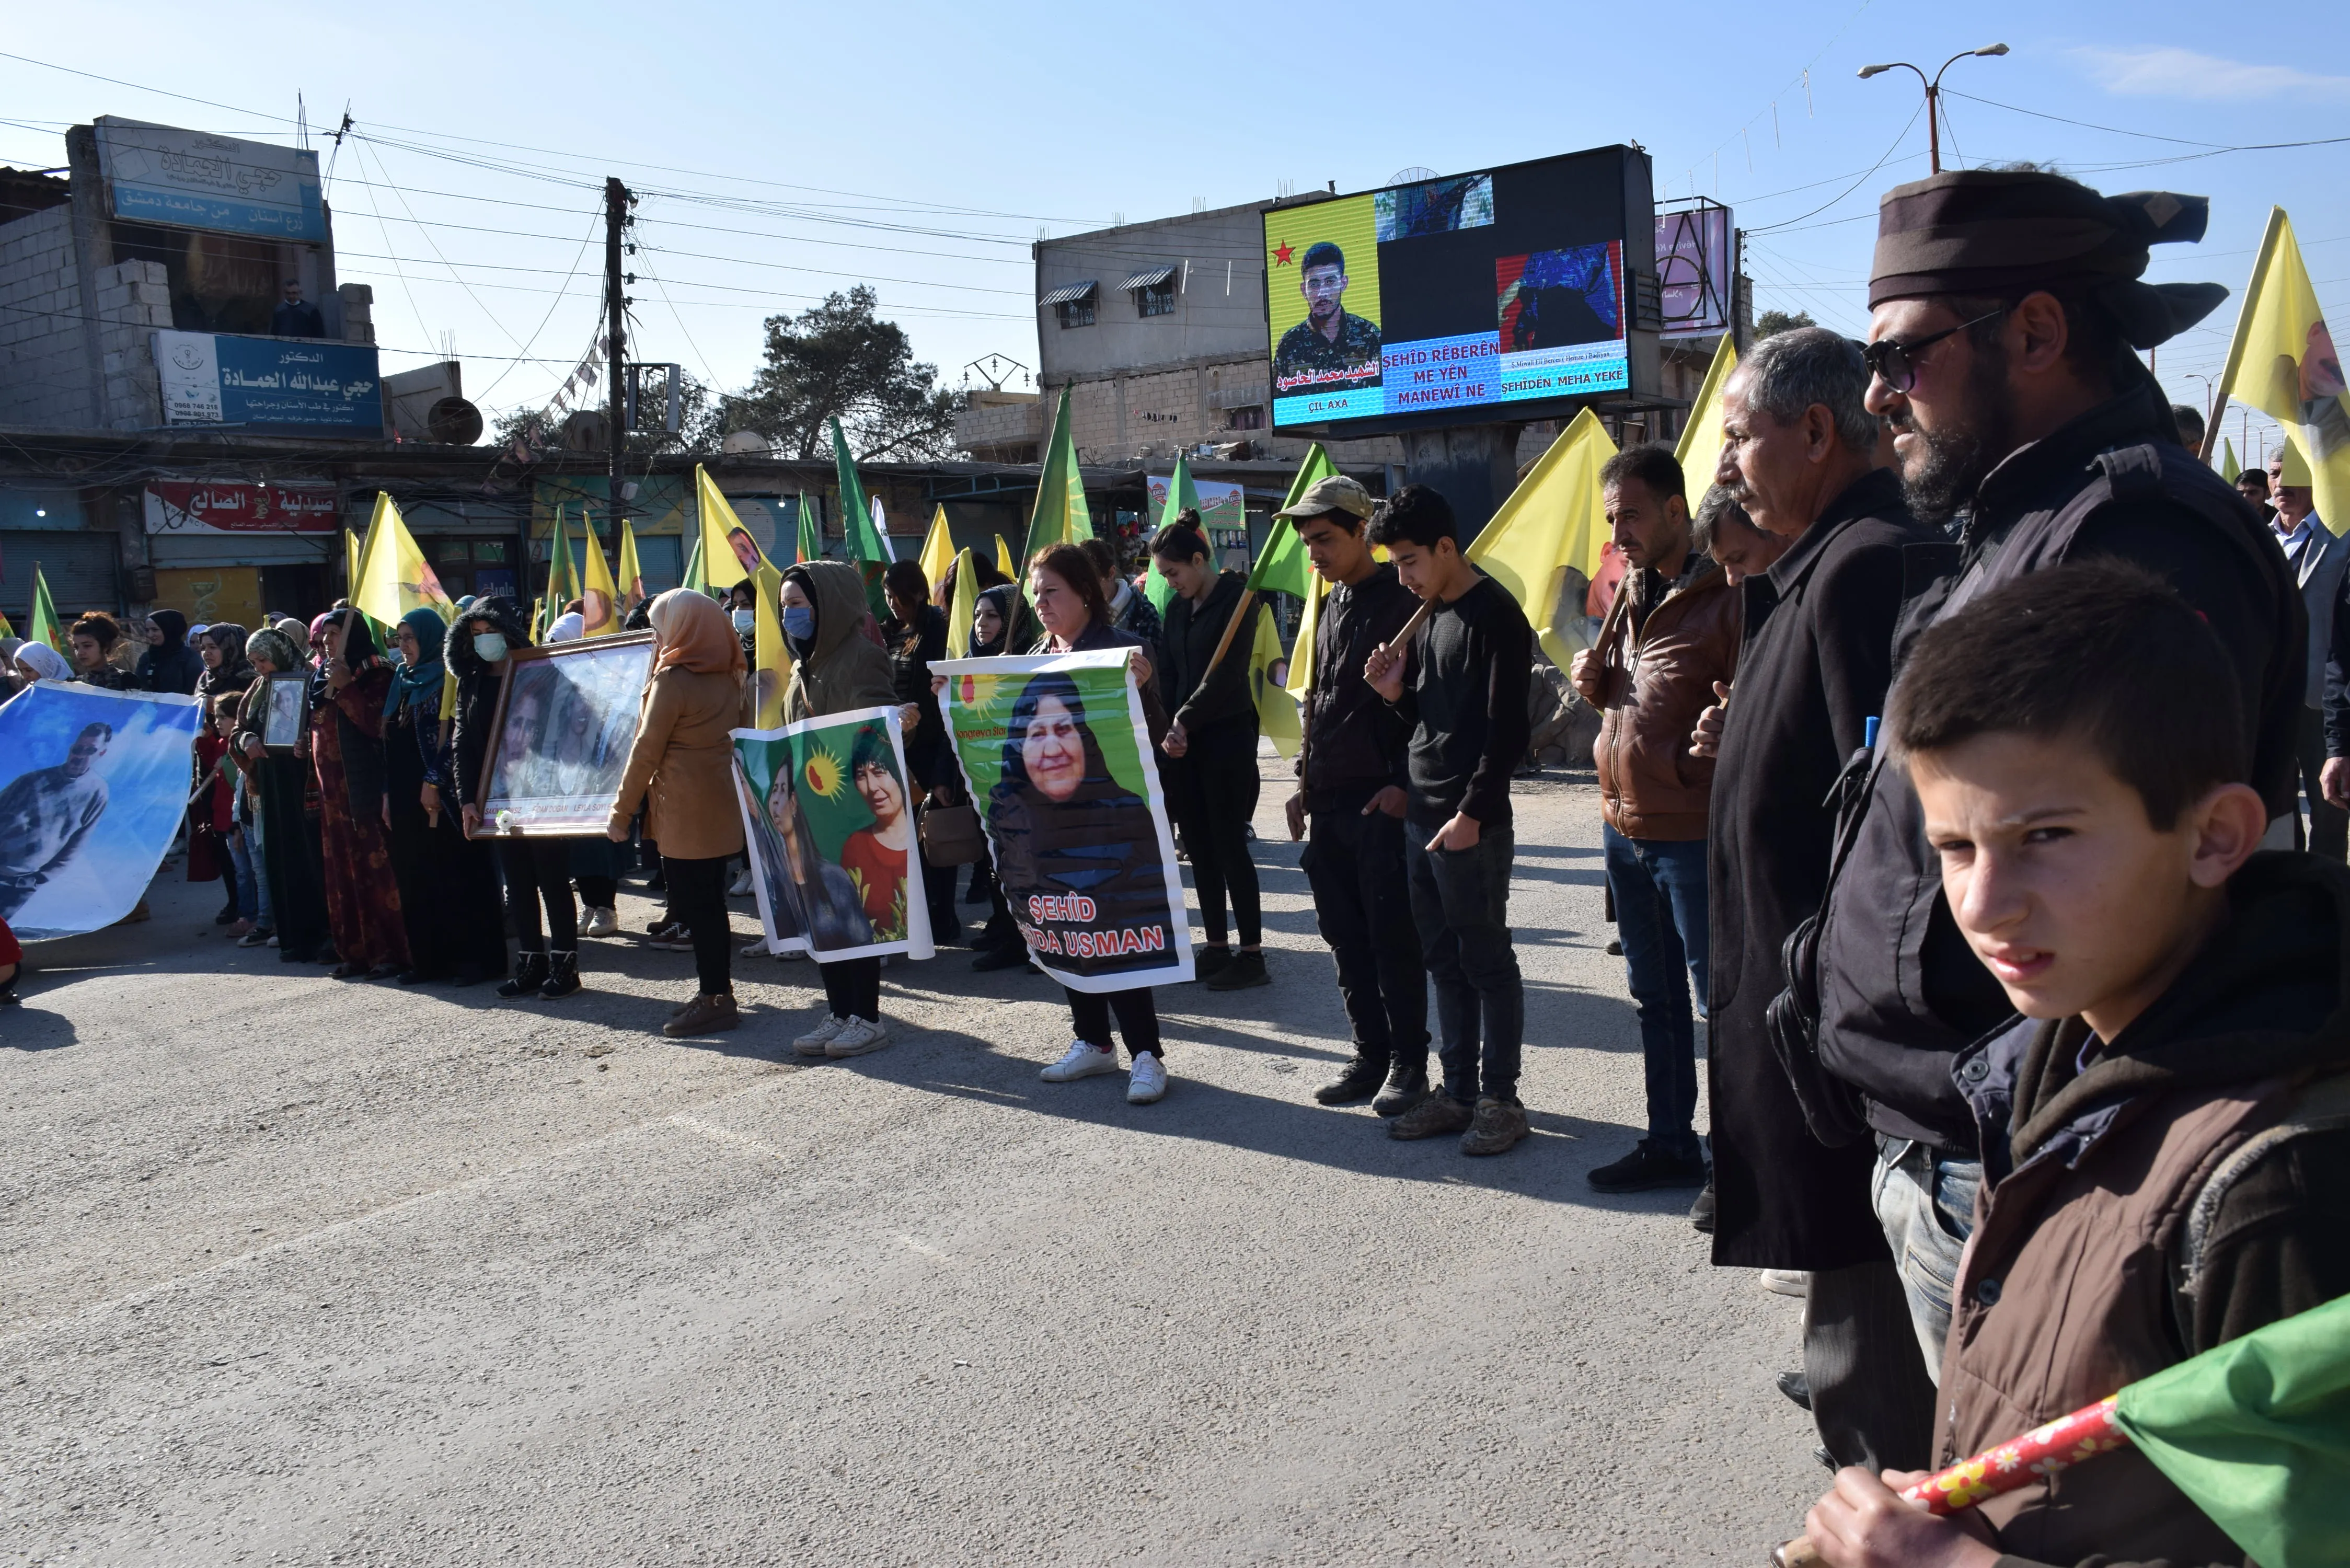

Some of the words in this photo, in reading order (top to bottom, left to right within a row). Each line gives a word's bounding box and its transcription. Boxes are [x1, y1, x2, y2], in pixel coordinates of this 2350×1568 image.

[192, 138, 240, 153] الدكتور
[235, 168, 282, 195] حجي
[121, 191, 162, 207] دمشق
[166, 195, 206, 213] جامعة
[211, 206, 230, 219] من
[279, 351, 324, 364] الدكتور
[1382, 349, 1427, 372] ŞEHÎD
[1432, 340, 1500, 362] RÊBERÊN
[222, 367, 286, 388] الحمادة
[1318, 368, 1344, 384] محمد
[1345, 360, 1379, 384] الشهيد
[1414, 370, 1434, 384] ME
[1438, 364, 1467, 381] YÊN
[1501, 375, 1551, 394] ŞEHÎDÊN
[1558, 374, 1591, 386] MEHA
[1594, 366, 1623, 382] YEKÊ
[290, 368, 339, 397] عبدالله
[343, 380, 373, 402] حجي
[1398, 383, 1461, 405] MANEWÎ
[1466, 383, 1485, 398] NE
[246, 399, 281, 410] وجراحتها
[307, 400, 321, 411] طب
[321, 402, 331, 412] في
[331, 403, 354, 413] دكتور
[1308, 401, 1325, 413] ÇIL
[1328, 399, 1348, 409] AXA
[190, 490, 246, 516] الصالح
[279, 490, 333, 516] صيدلية
[1029, 891, 1096, 925] ŞEHÎD
[1064, 925, 1165, 959] USMAN
